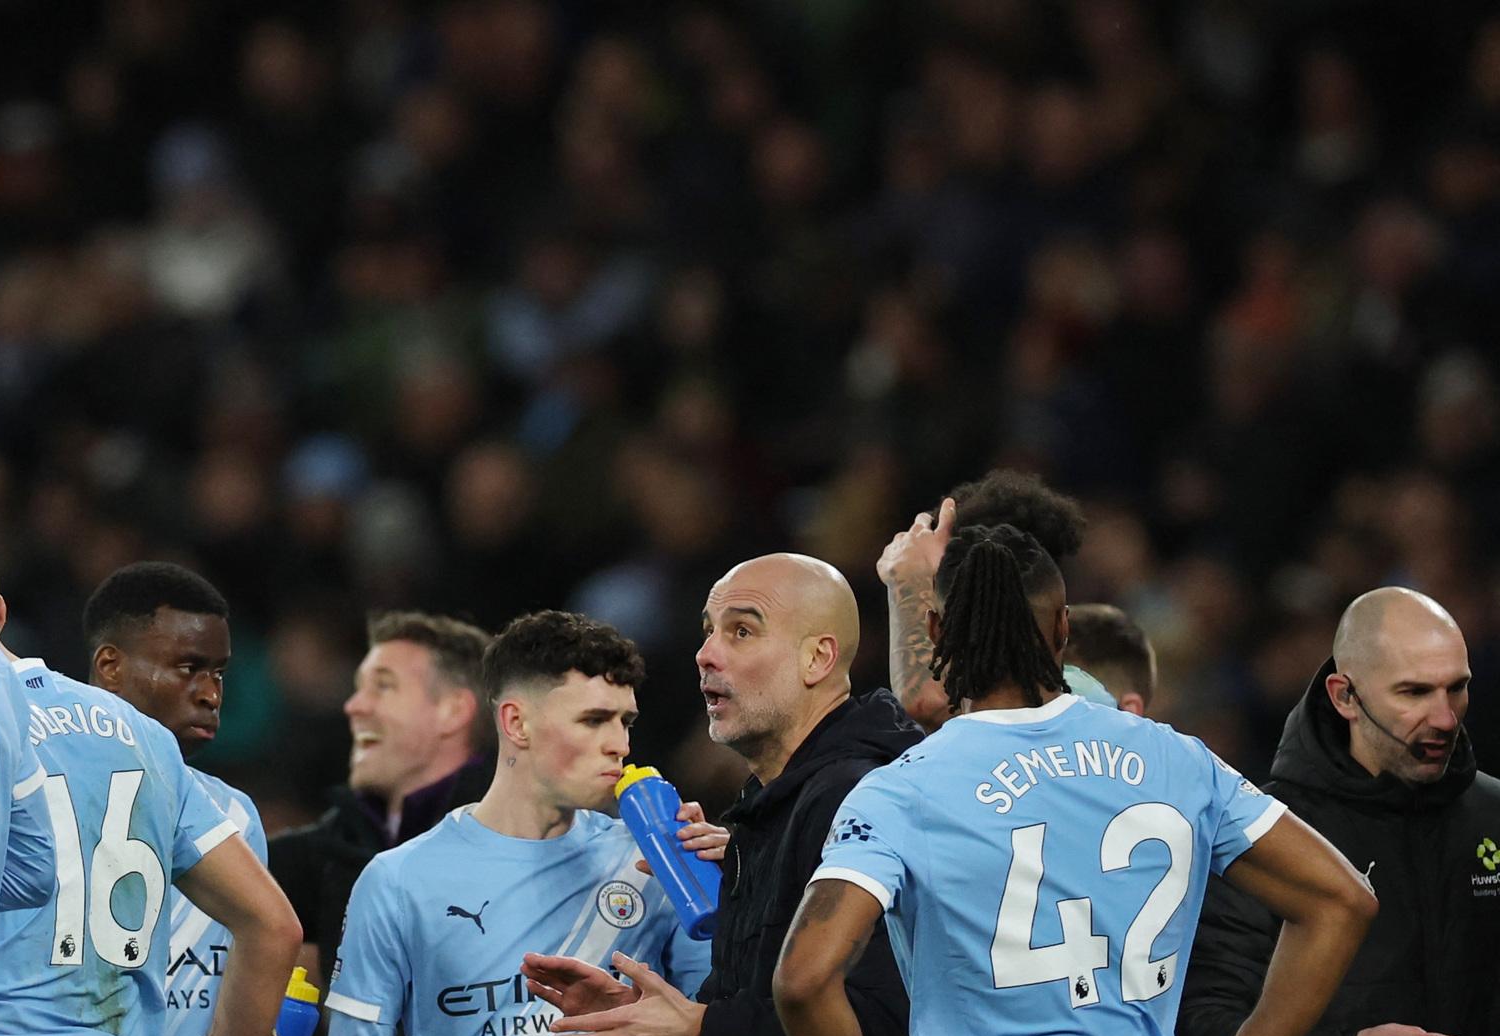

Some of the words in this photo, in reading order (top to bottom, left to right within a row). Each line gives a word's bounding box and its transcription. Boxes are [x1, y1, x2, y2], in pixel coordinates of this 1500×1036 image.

[28, 702, 136, 746] ODRIGO
[974, 740, 1146, 815] SEMENYO
[46, 769, 166, 969] 16
[990, 801, 1194, 1010] 42
